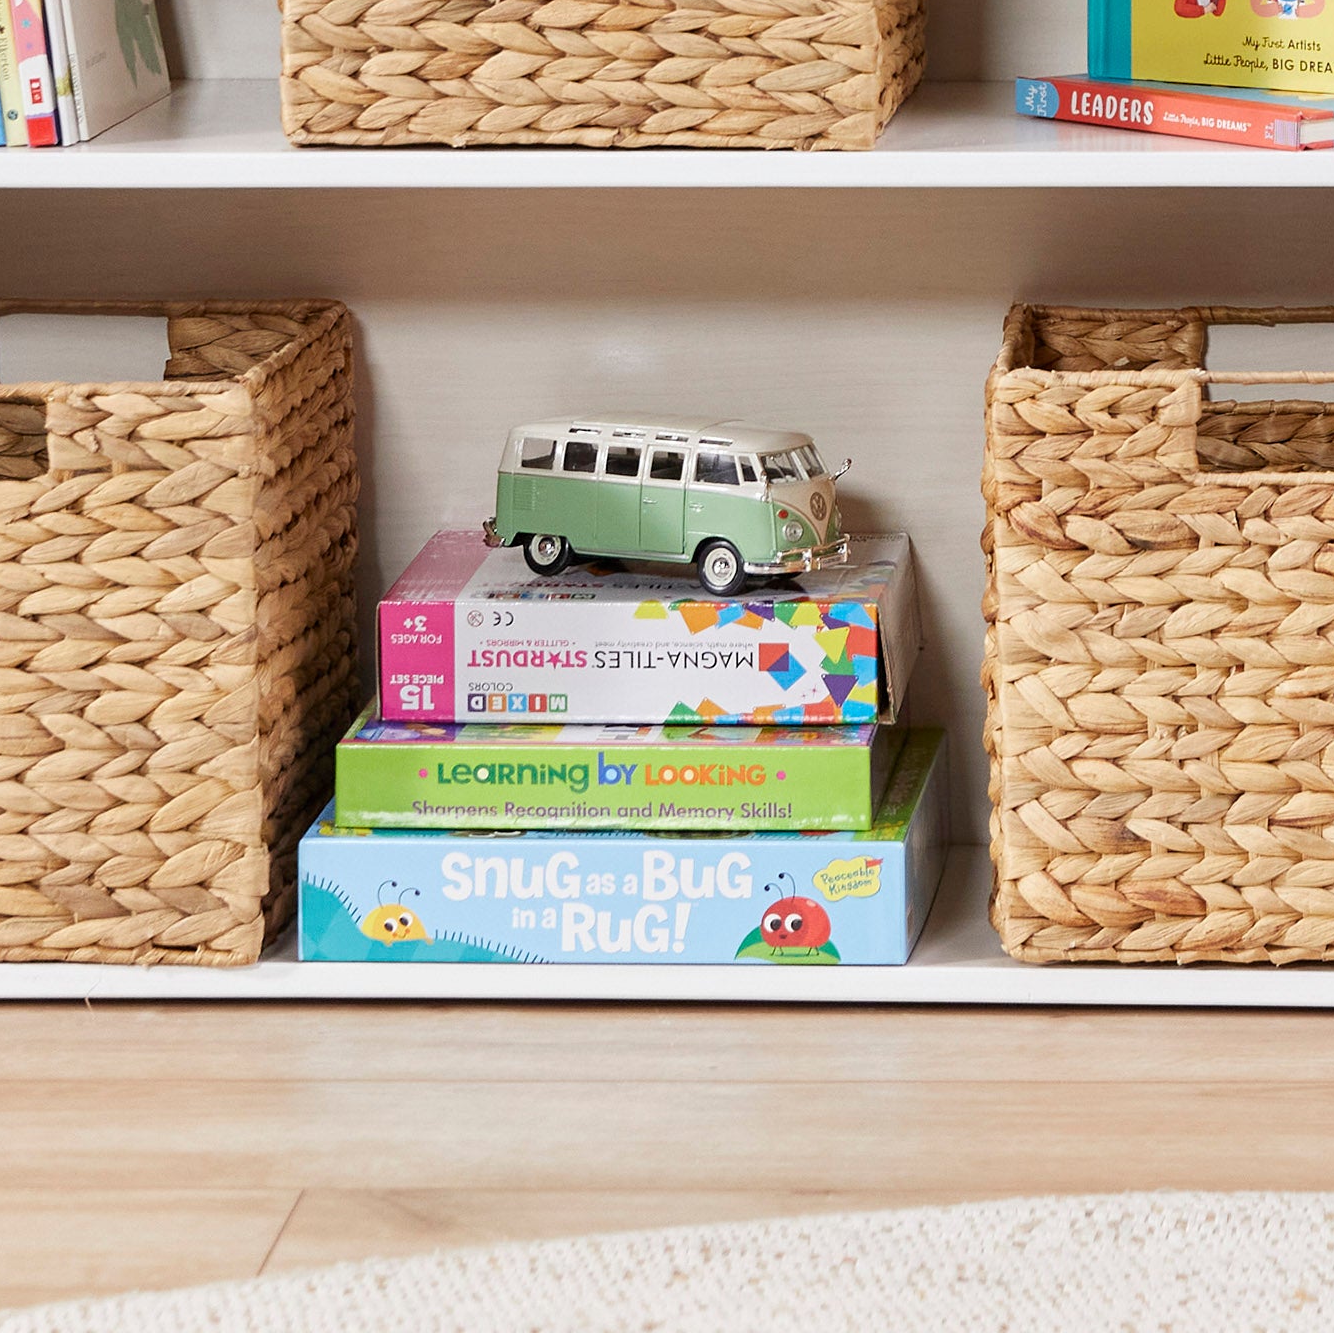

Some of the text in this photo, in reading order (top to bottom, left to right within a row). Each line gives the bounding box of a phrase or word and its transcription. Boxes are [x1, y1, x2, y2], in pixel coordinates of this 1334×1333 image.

[1242, 36, 1322, 52] My First Artists
[1203, 53, 1231, 67] Little
[1233, 54, 1269, 73] People,
[1272, 58, 1295, 71] BIG
[1025, 84, 1038, 112] My
[1037, 82, 1047, 117] First
[1070, 91, 1155, 126] LEADERS
[1201, 117, 1215, 129] BIG
[403, 615, 427, 632] 3+
[391, 634, 442, 644] FOR AGES
[485, 639, 524, 647] MIRRORS
[535, 639, 570, 647] GLITTER
[595, 641, 616, 649] meet
[617, 640, 654, 650] creativity
[655, 641, 671, 649] and
[728, 641, 754, 649] where
[390, 674, 444, 685] PIECE SET
[468, 682, 514, 691] COLORS
[400, 684, 435, 711] 15
[468, 694, 567, 712] MIXED
[412, 800, 792, 820] Sharpens Recognition and Memory Skills!
[586, 871, 617, 896] as
[622, 871, 638, 895] a
[820, 867, 875, 884] Peaceable
[829, 880, 872, 896] Kingdom
[512, 906, 536, 929] in
[541, 905, 557, 929] a
